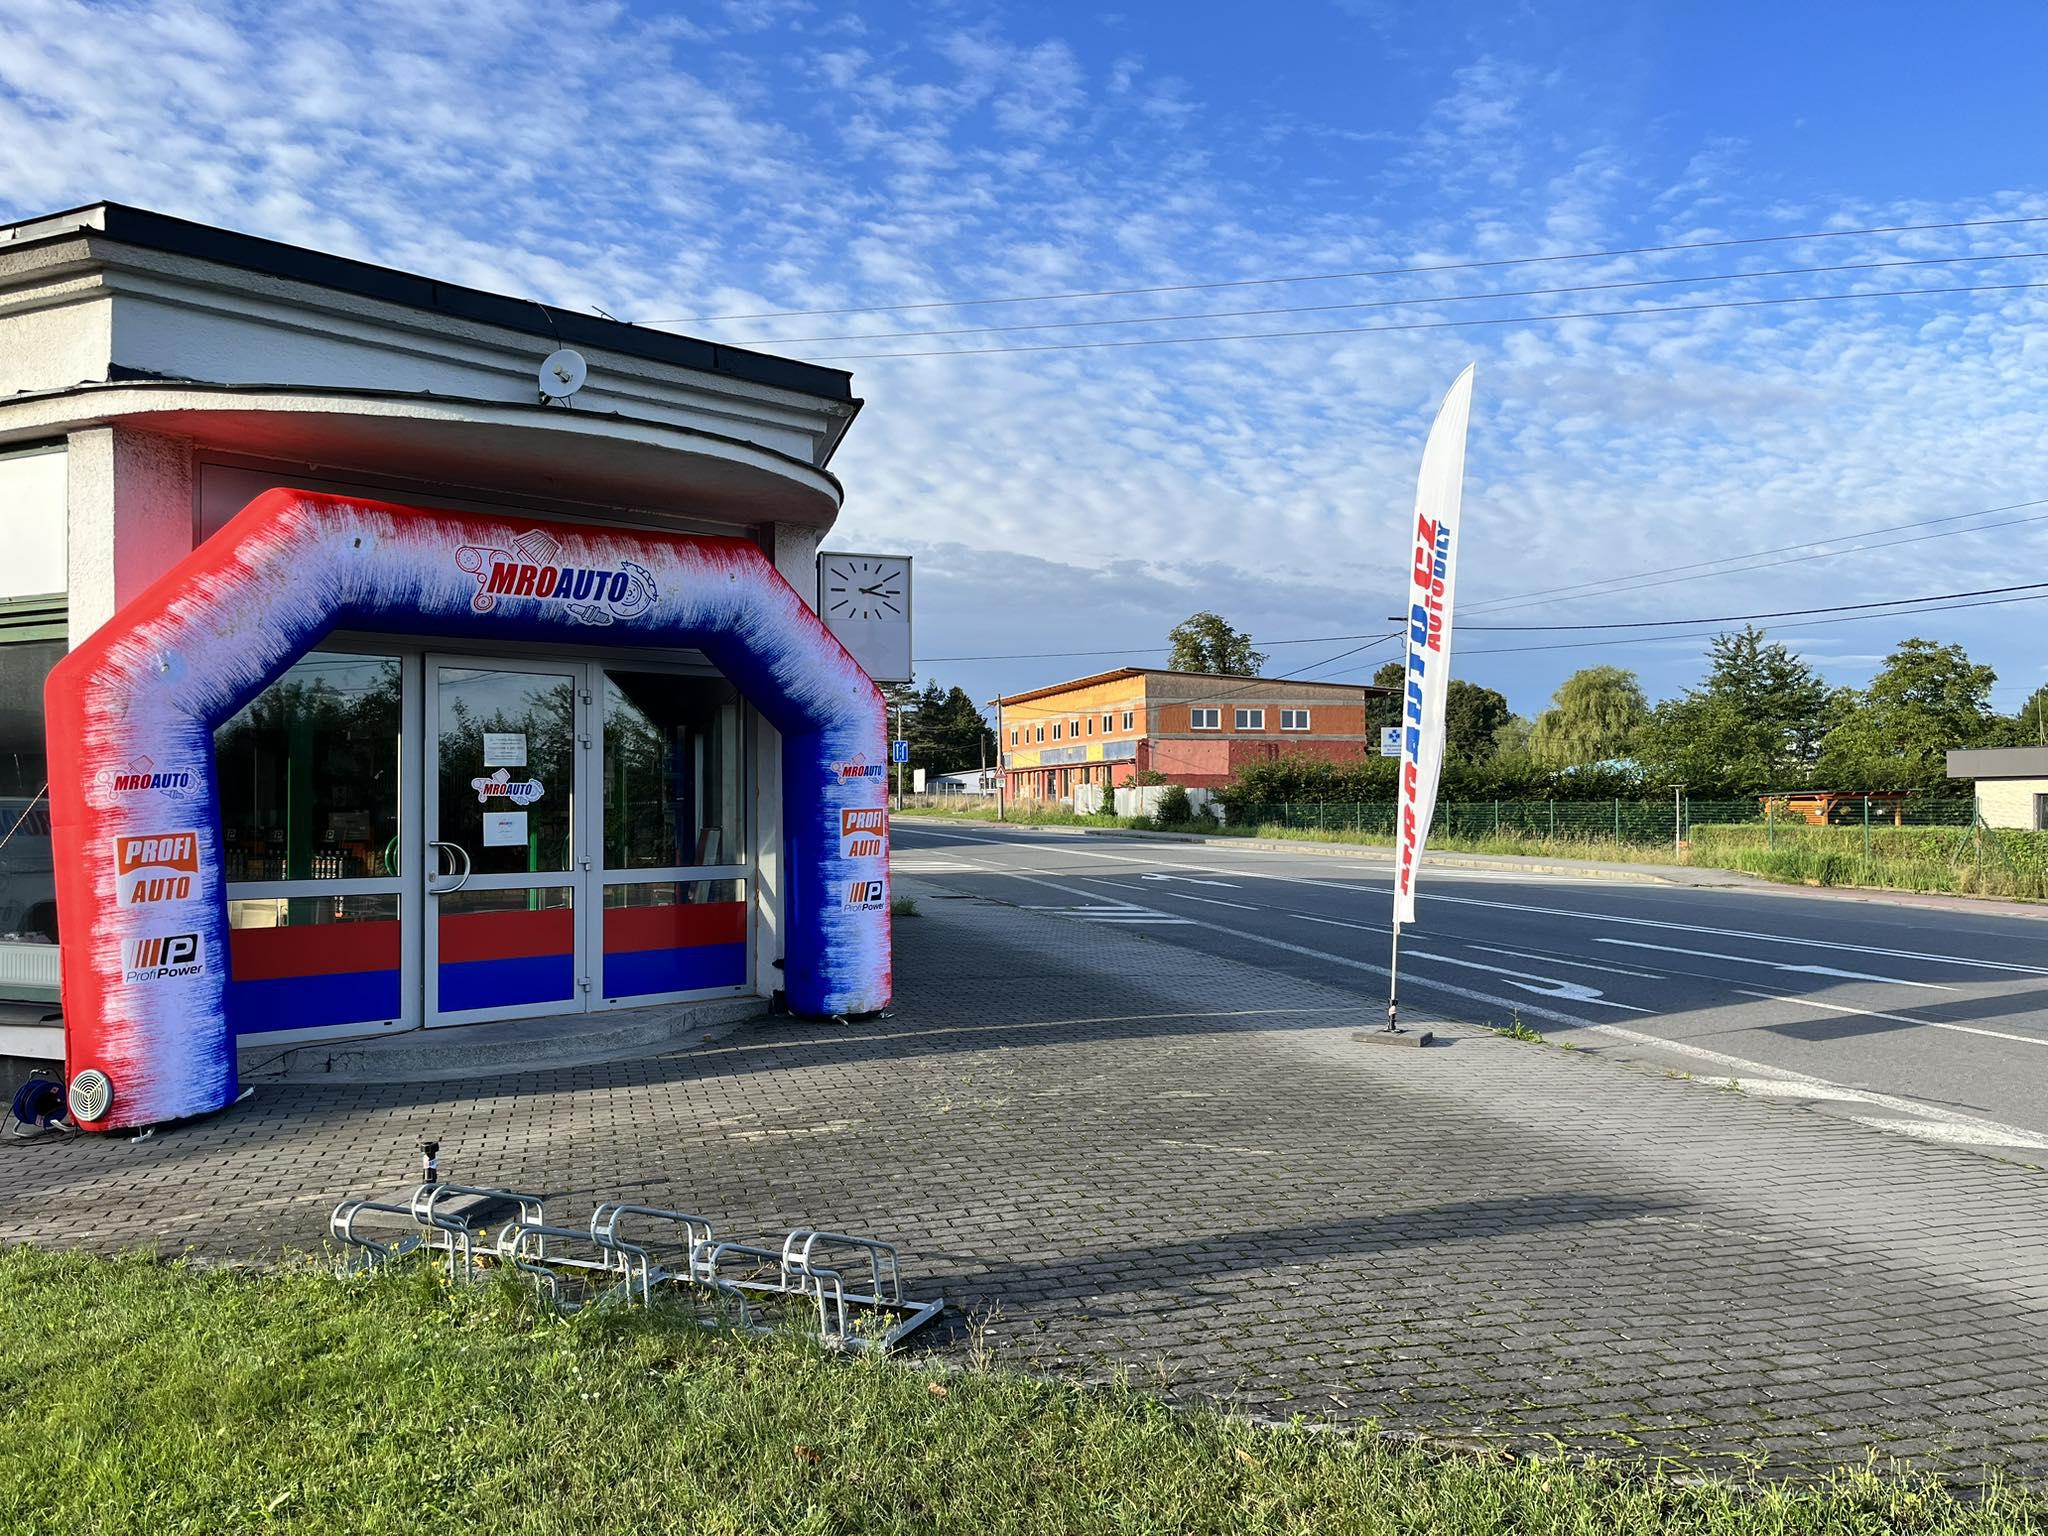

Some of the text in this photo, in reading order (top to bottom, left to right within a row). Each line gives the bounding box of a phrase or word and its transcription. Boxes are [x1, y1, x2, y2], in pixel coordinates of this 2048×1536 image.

[487, 562, 629, 603] MROAUTO
[842, 765, 883, 778] MROAUTO
[114, 772, 189, 791] MROAUTO
[483, 783, 533, 796] MROAUTO
[846, 811, 882, 829] PROFI
[125, 837, 192, 865] PROFI
[849, 839, 881, 857] AUTO
[131, 876, 192, 904] AUTO
[844, 903, 884, 913] ProfiPower
[126, 964, 203, 983] ProfiPower
